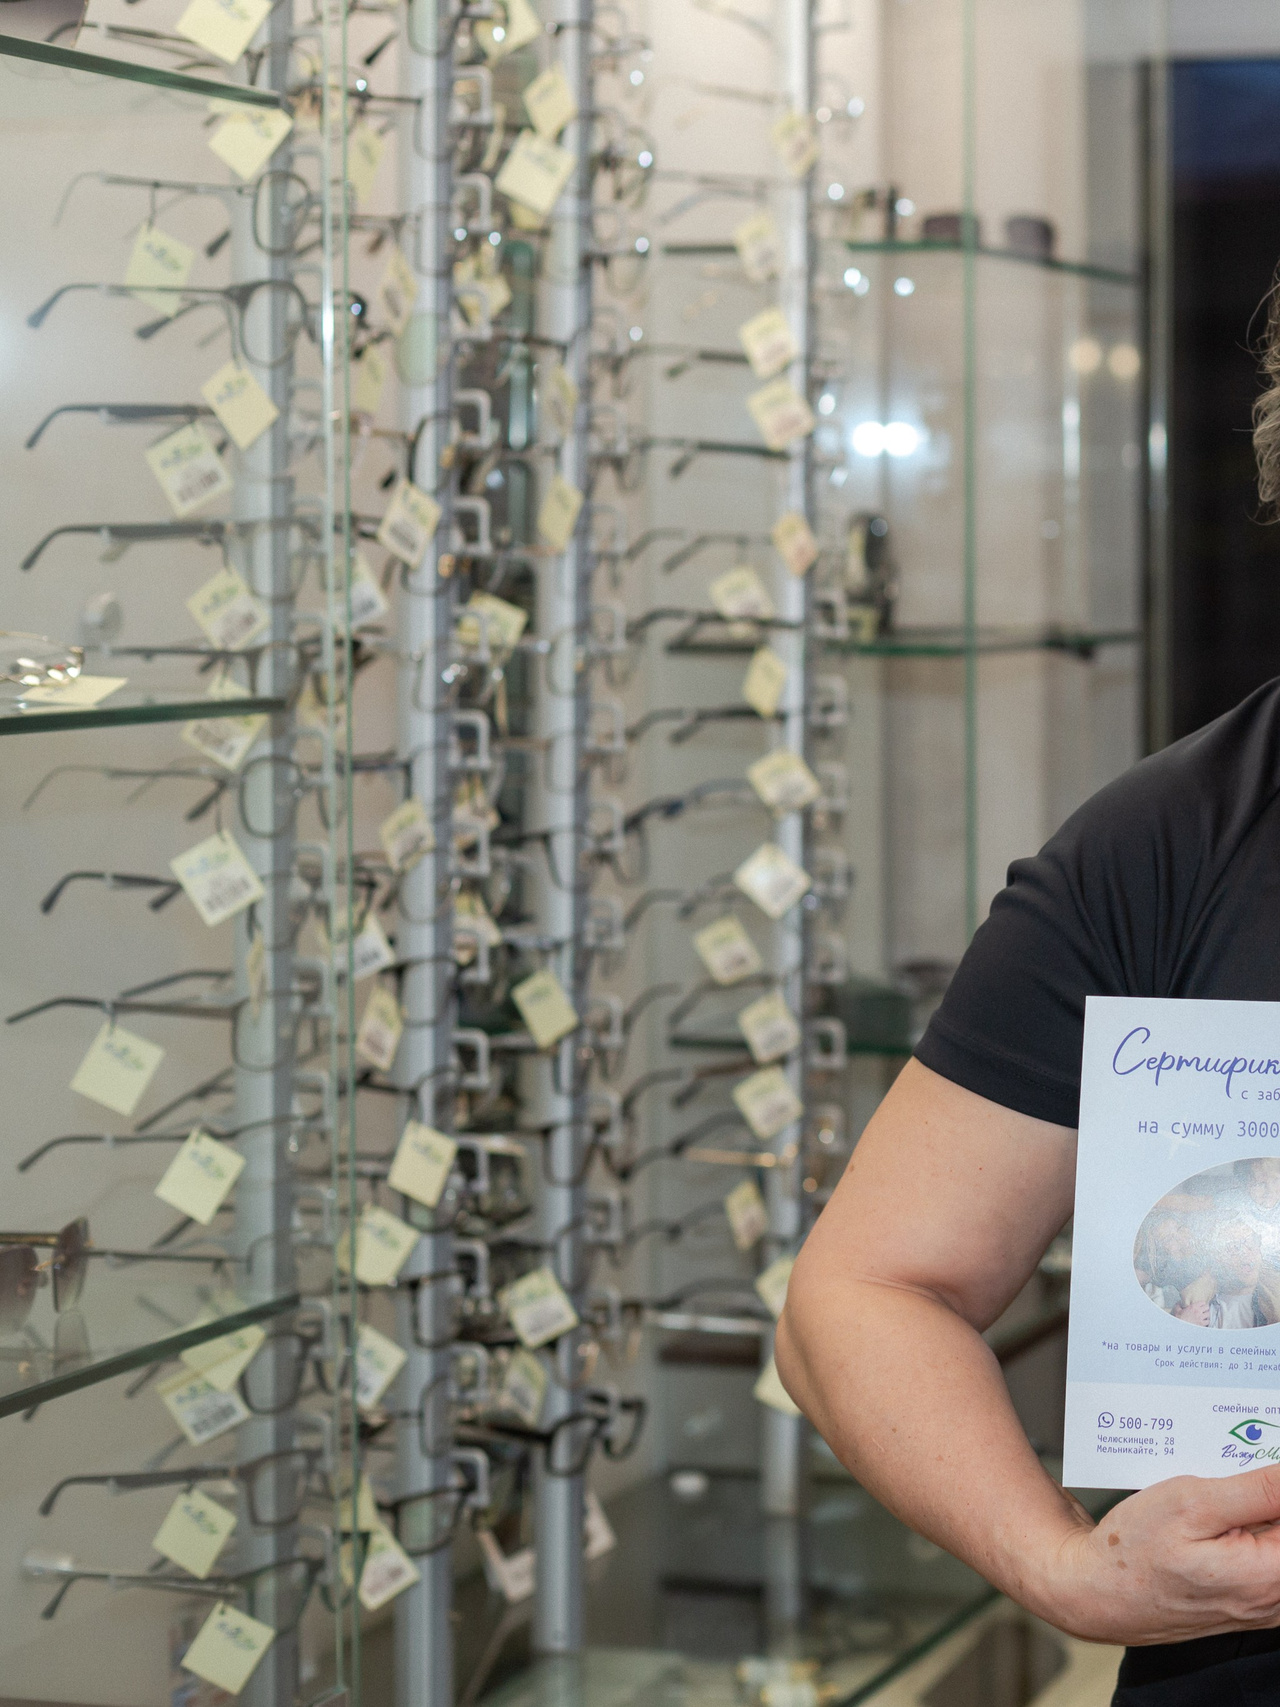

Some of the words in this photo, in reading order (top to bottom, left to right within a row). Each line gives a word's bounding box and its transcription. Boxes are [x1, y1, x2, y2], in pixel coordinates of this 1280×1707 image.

[1241, 1090, 1249, 1100] с
[1138, 1120, 1159, 1134] на
[1171, 1121, 1225, 1140] сумму
[1237, 1120, 1280, 1139] 3000
[1125, 1342, 1161, 1354] товары
[1165, 1344, 1172, 1352] и
[1177, 1345, 1213, 1356] услуги
[1218, 1346, 1224, 1355] в
[1229, 1345, 1277, 1357] семейных
[1154, 1357, 1175, 1369] Срок
[1178, 1360, 1223, 1370] действия:
[1228, 1362, 1239, 1371] до
[1243, 1361, 1253, 1371] 31
[1212, 1404, 1260, 1414] семейные
[1118, 1416, 1174, 1431] 500-799
[1096, 1434, 1159, 1447] Челюскинцев,
[1164, 1436, 1175, 1446] 28
[1096, 1445, 1158, 1457] Мельникайте,
[1163, 1446, 1175, 1456] 94
